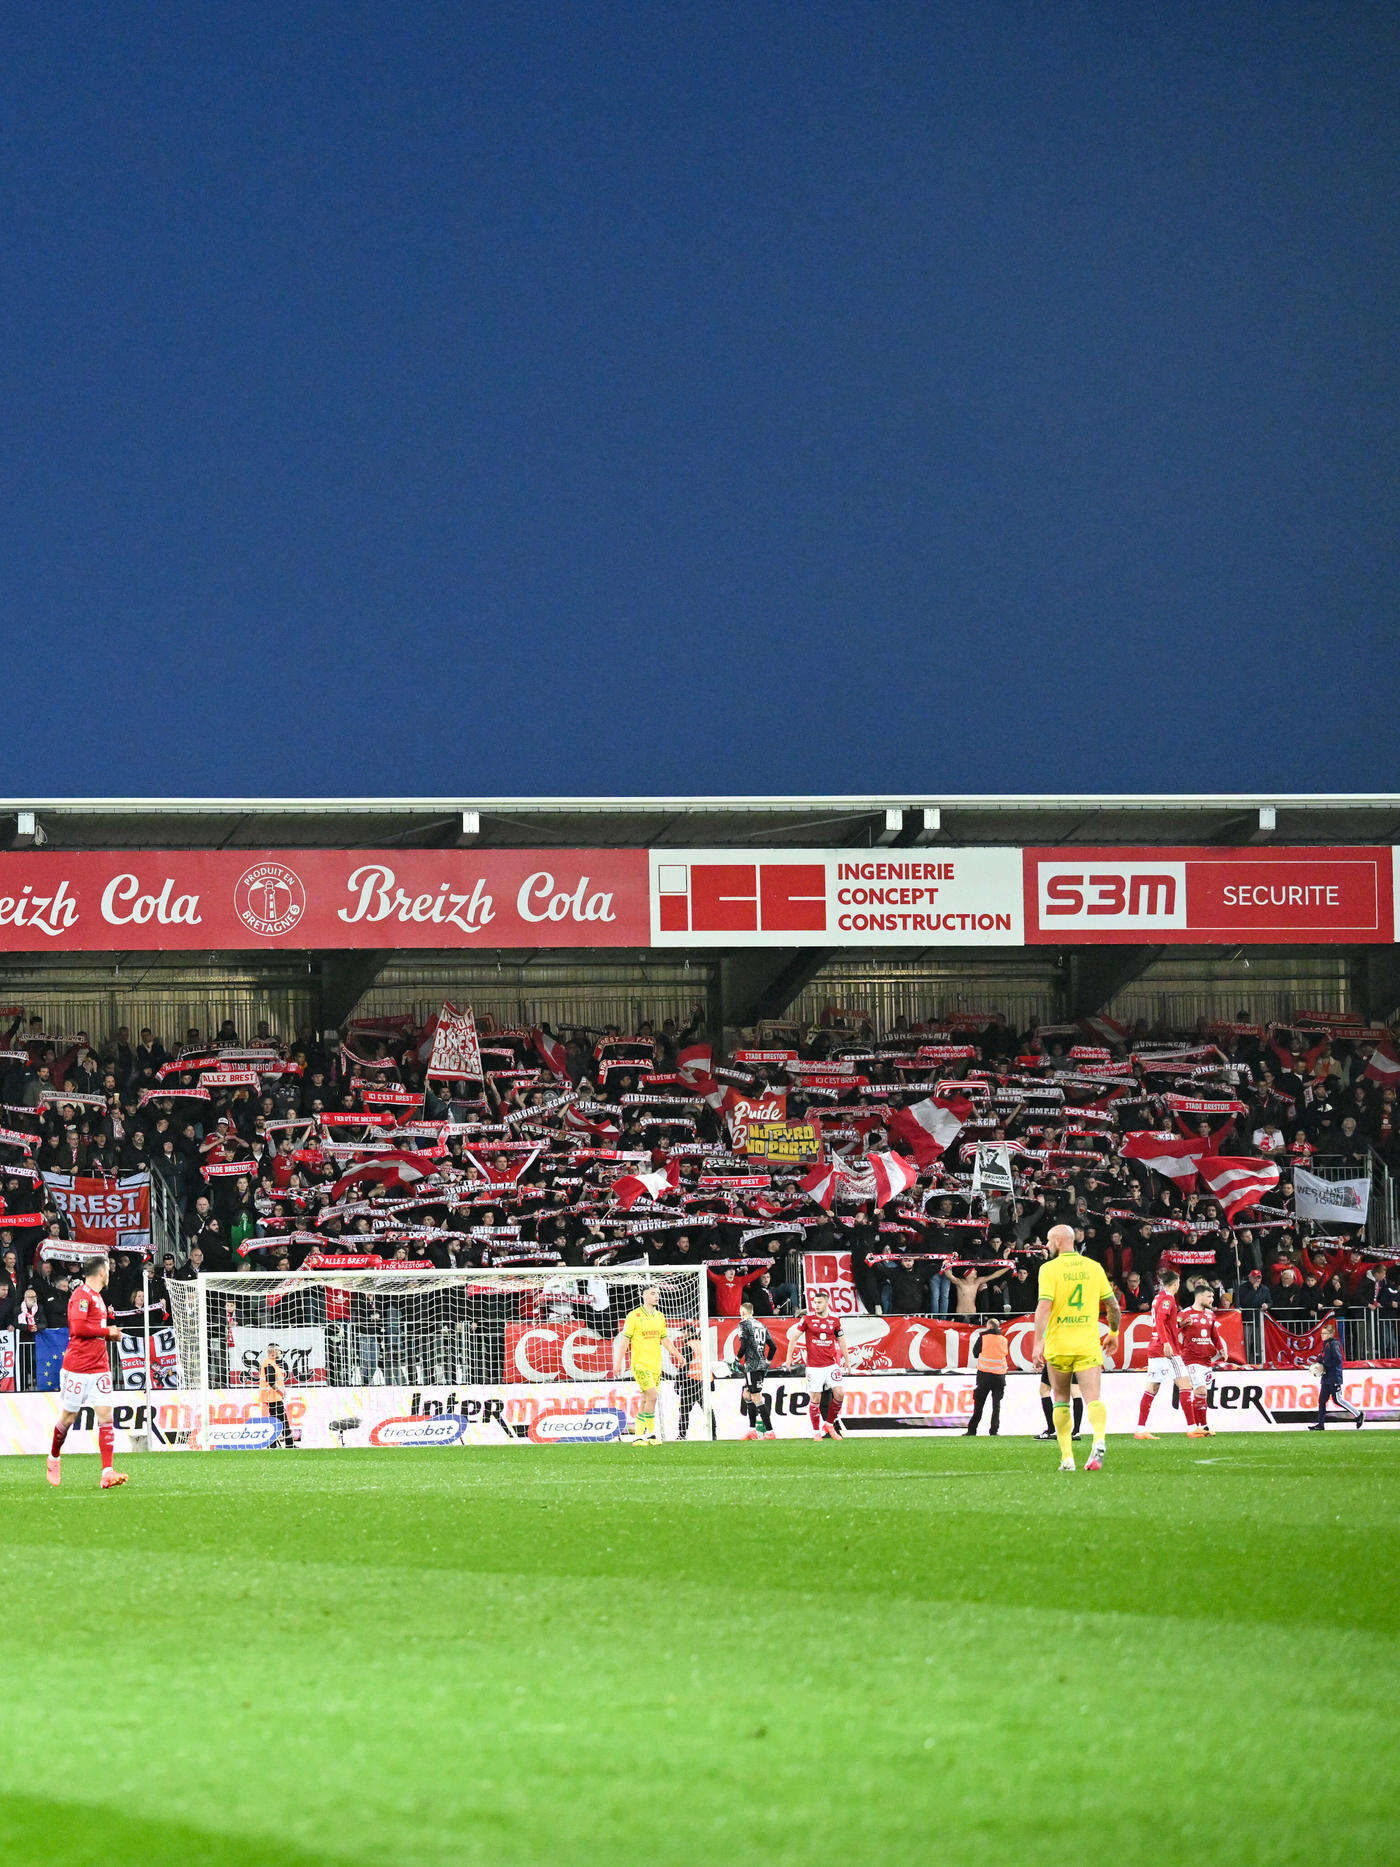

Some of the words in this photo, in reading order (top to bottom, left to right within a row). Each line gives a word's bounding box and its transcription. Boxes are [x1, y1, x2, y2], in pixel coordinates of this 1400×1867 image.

[244, 868, 284, 887] PRODUIT
[283, 873, 296, 887] EN
[837, 862, 955, 881] INGENIERIE
[100, 873, 202, 926] Cola
[337, 864, 497, 934] Breizh
[516, 871, 617, 923] Cola
[837, 887, 939, 906] CONCEPT
[1045, 874, 1177, 916] S3M
[1222, 885, 1341, 907] SECURITE
[241, 910, 295, 933] BRETAGNE
[837, 912, 1012, 932] CONSTRUCTION
[202, 1074, 227, 1084] ALLEZ
[228, 1072, 256, 1082] BREST
[394, 1093, 414, 1102] BREST
[768, 1141, 820, 1155] PARTY
[204, 1163, 224, 1174] STADE
[224, 1162, 253, 1173] BRESTOIS
[53, 1191, 140, 1214] BREST
[80, 1211, 141, 1229] VIKEN
[323, 1256, 347, 1266] ALLEZ
[346, 1255, 370, 1266] BREST
[1066, 1282, 1085, 1312] 4
[1055, 1314, 1092, 1325] MILLET
[383, 1422, 454, 1439] trecobat
[540, 1416, 613, 1433] trecobat
